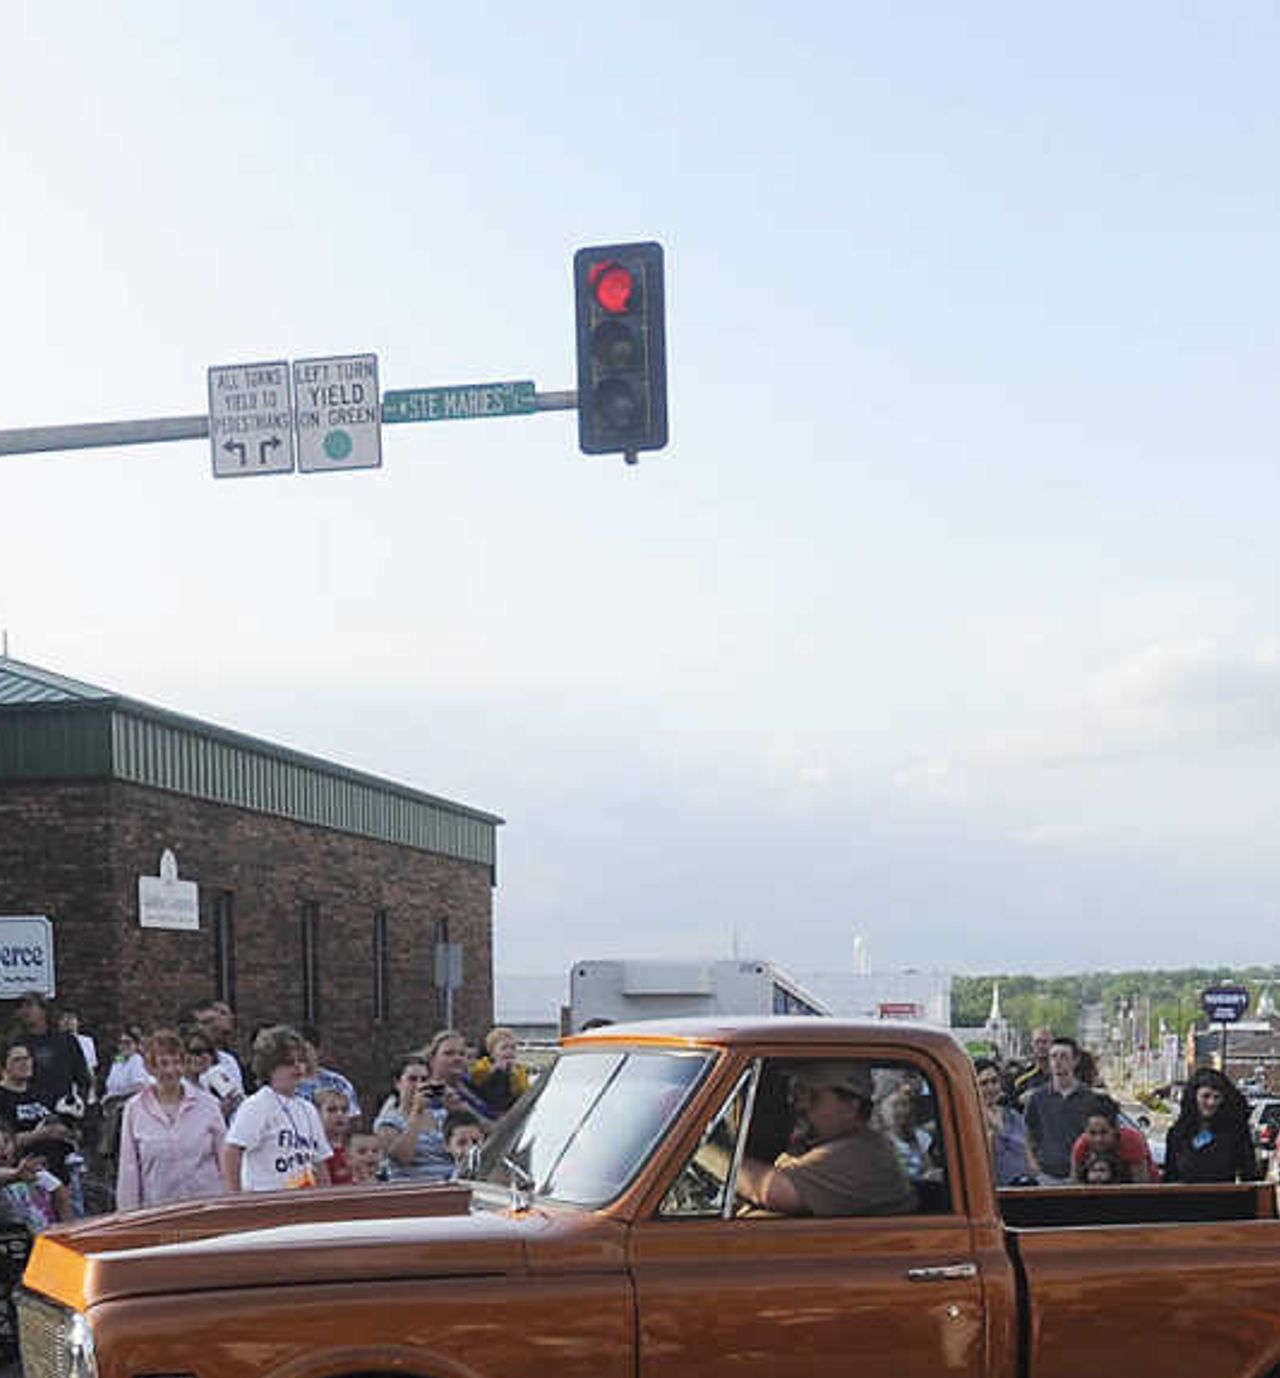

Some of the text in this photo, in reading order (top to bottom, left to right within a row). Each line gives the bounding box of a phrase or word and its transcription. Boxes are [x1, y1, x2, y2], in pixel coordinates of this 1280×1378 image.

[217, 373, 238, 389] ALL
[295, 361, 373, 384] LEFT TURN
[309, 384, 364, 407] YIELD
[299, 411, 320, 427] ON
[328, 406, 376, 426] GREEN
